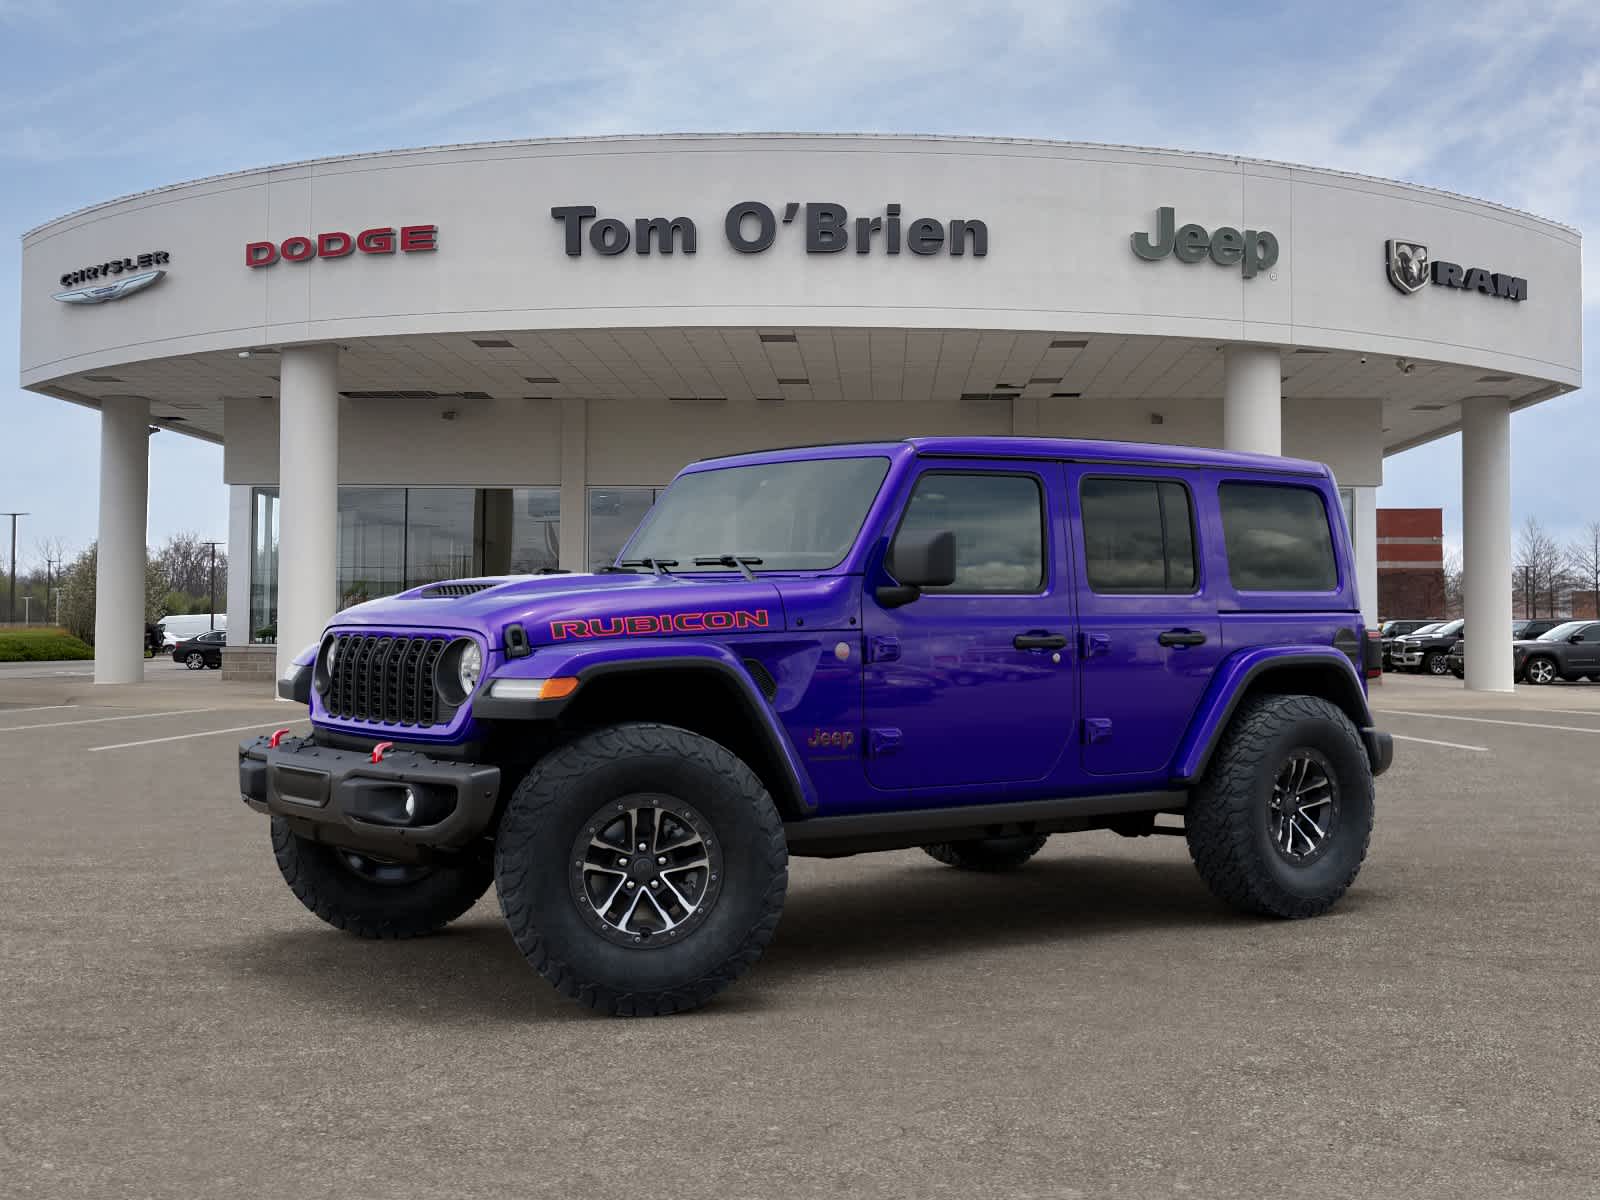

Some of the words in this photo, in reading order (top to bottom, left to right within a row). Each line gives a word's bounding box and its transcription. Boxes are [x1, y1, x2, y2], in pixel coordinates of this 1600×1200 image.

[245, 224, 438, 269] DODGE
[551, 205, 697, 256] Tom
[725, 201, 988, 256] O'Brien
[1131, 207, 1279, 279] Jeep
[60, 251, 170, 286] CHRYSLER
[1431, 261, 1528, 302] RAM
[551, 609, 769, 640] RUBICON
[808, 727, 855, 751] Jeep
